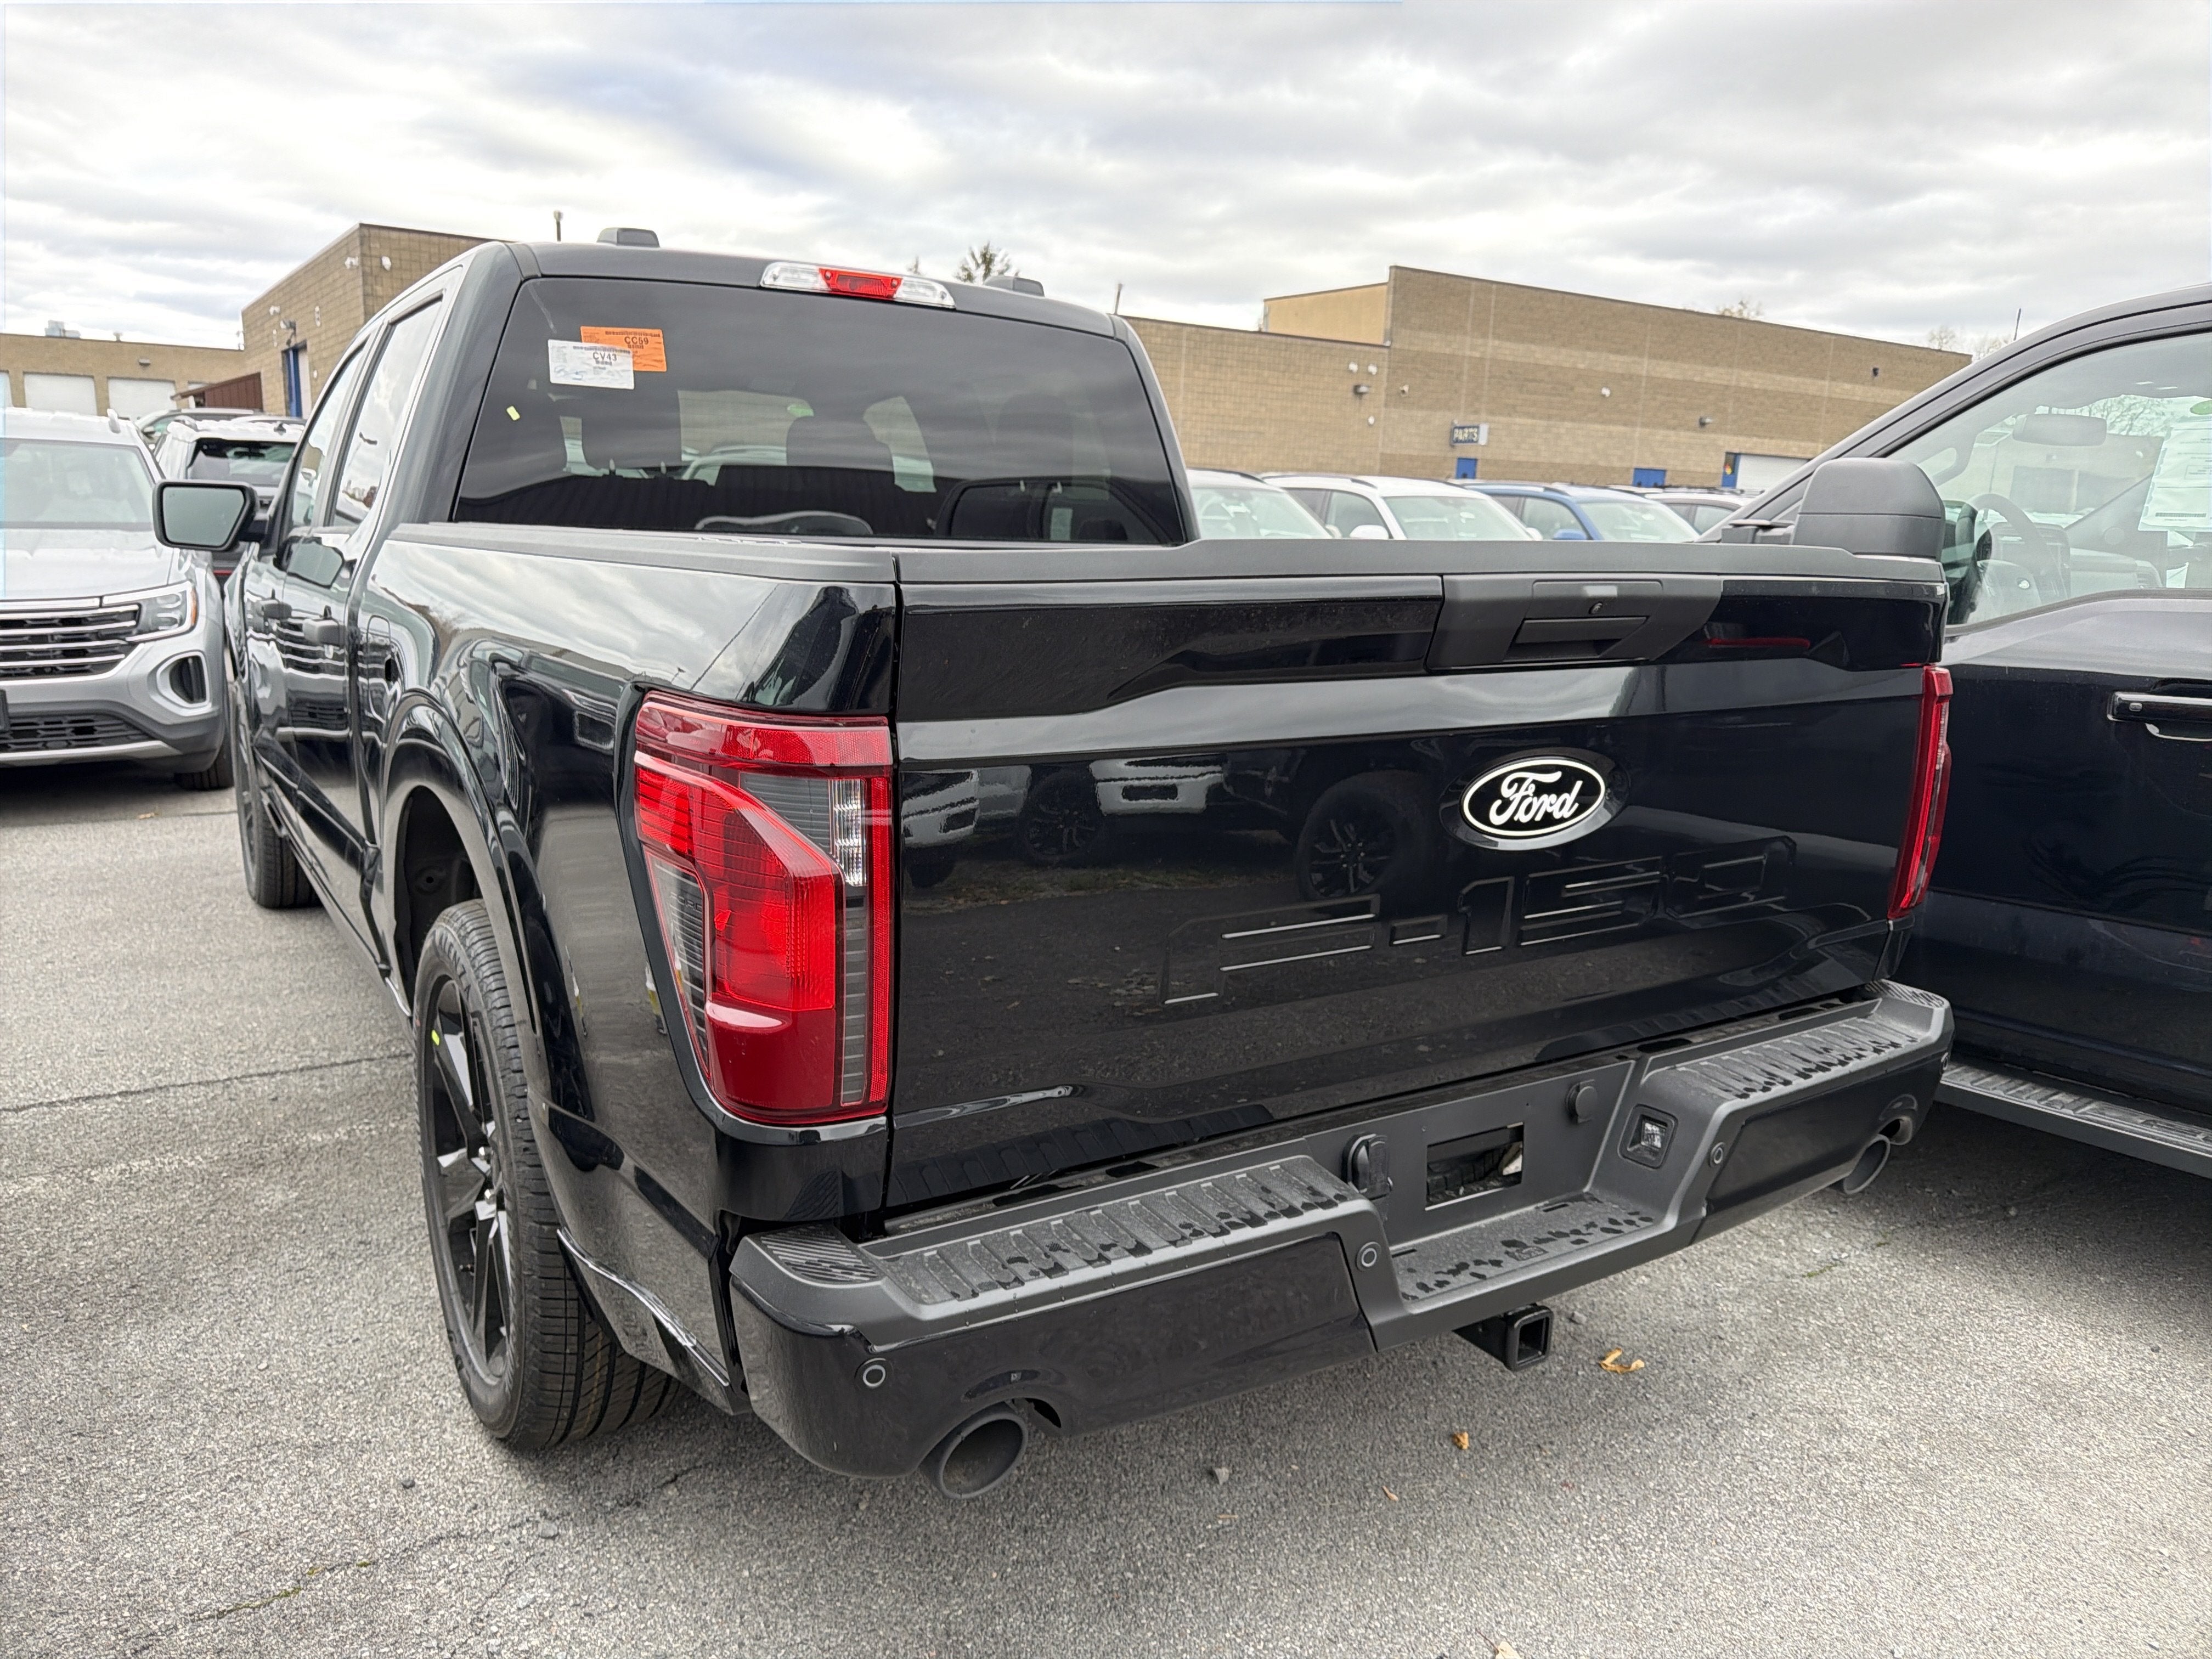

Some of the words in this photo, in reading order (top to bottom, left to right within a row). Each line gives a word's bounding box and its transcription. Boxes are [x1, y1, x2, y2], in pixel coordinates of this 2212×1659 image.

[624, 336, 649, 345] CC59
[592, 352, 617, 362] CV43
[1453, 427, 1478, 442] PARTS
[1489, 771, 1583, 826] Ford
[1161, 835, 1797, 1005] F-150
